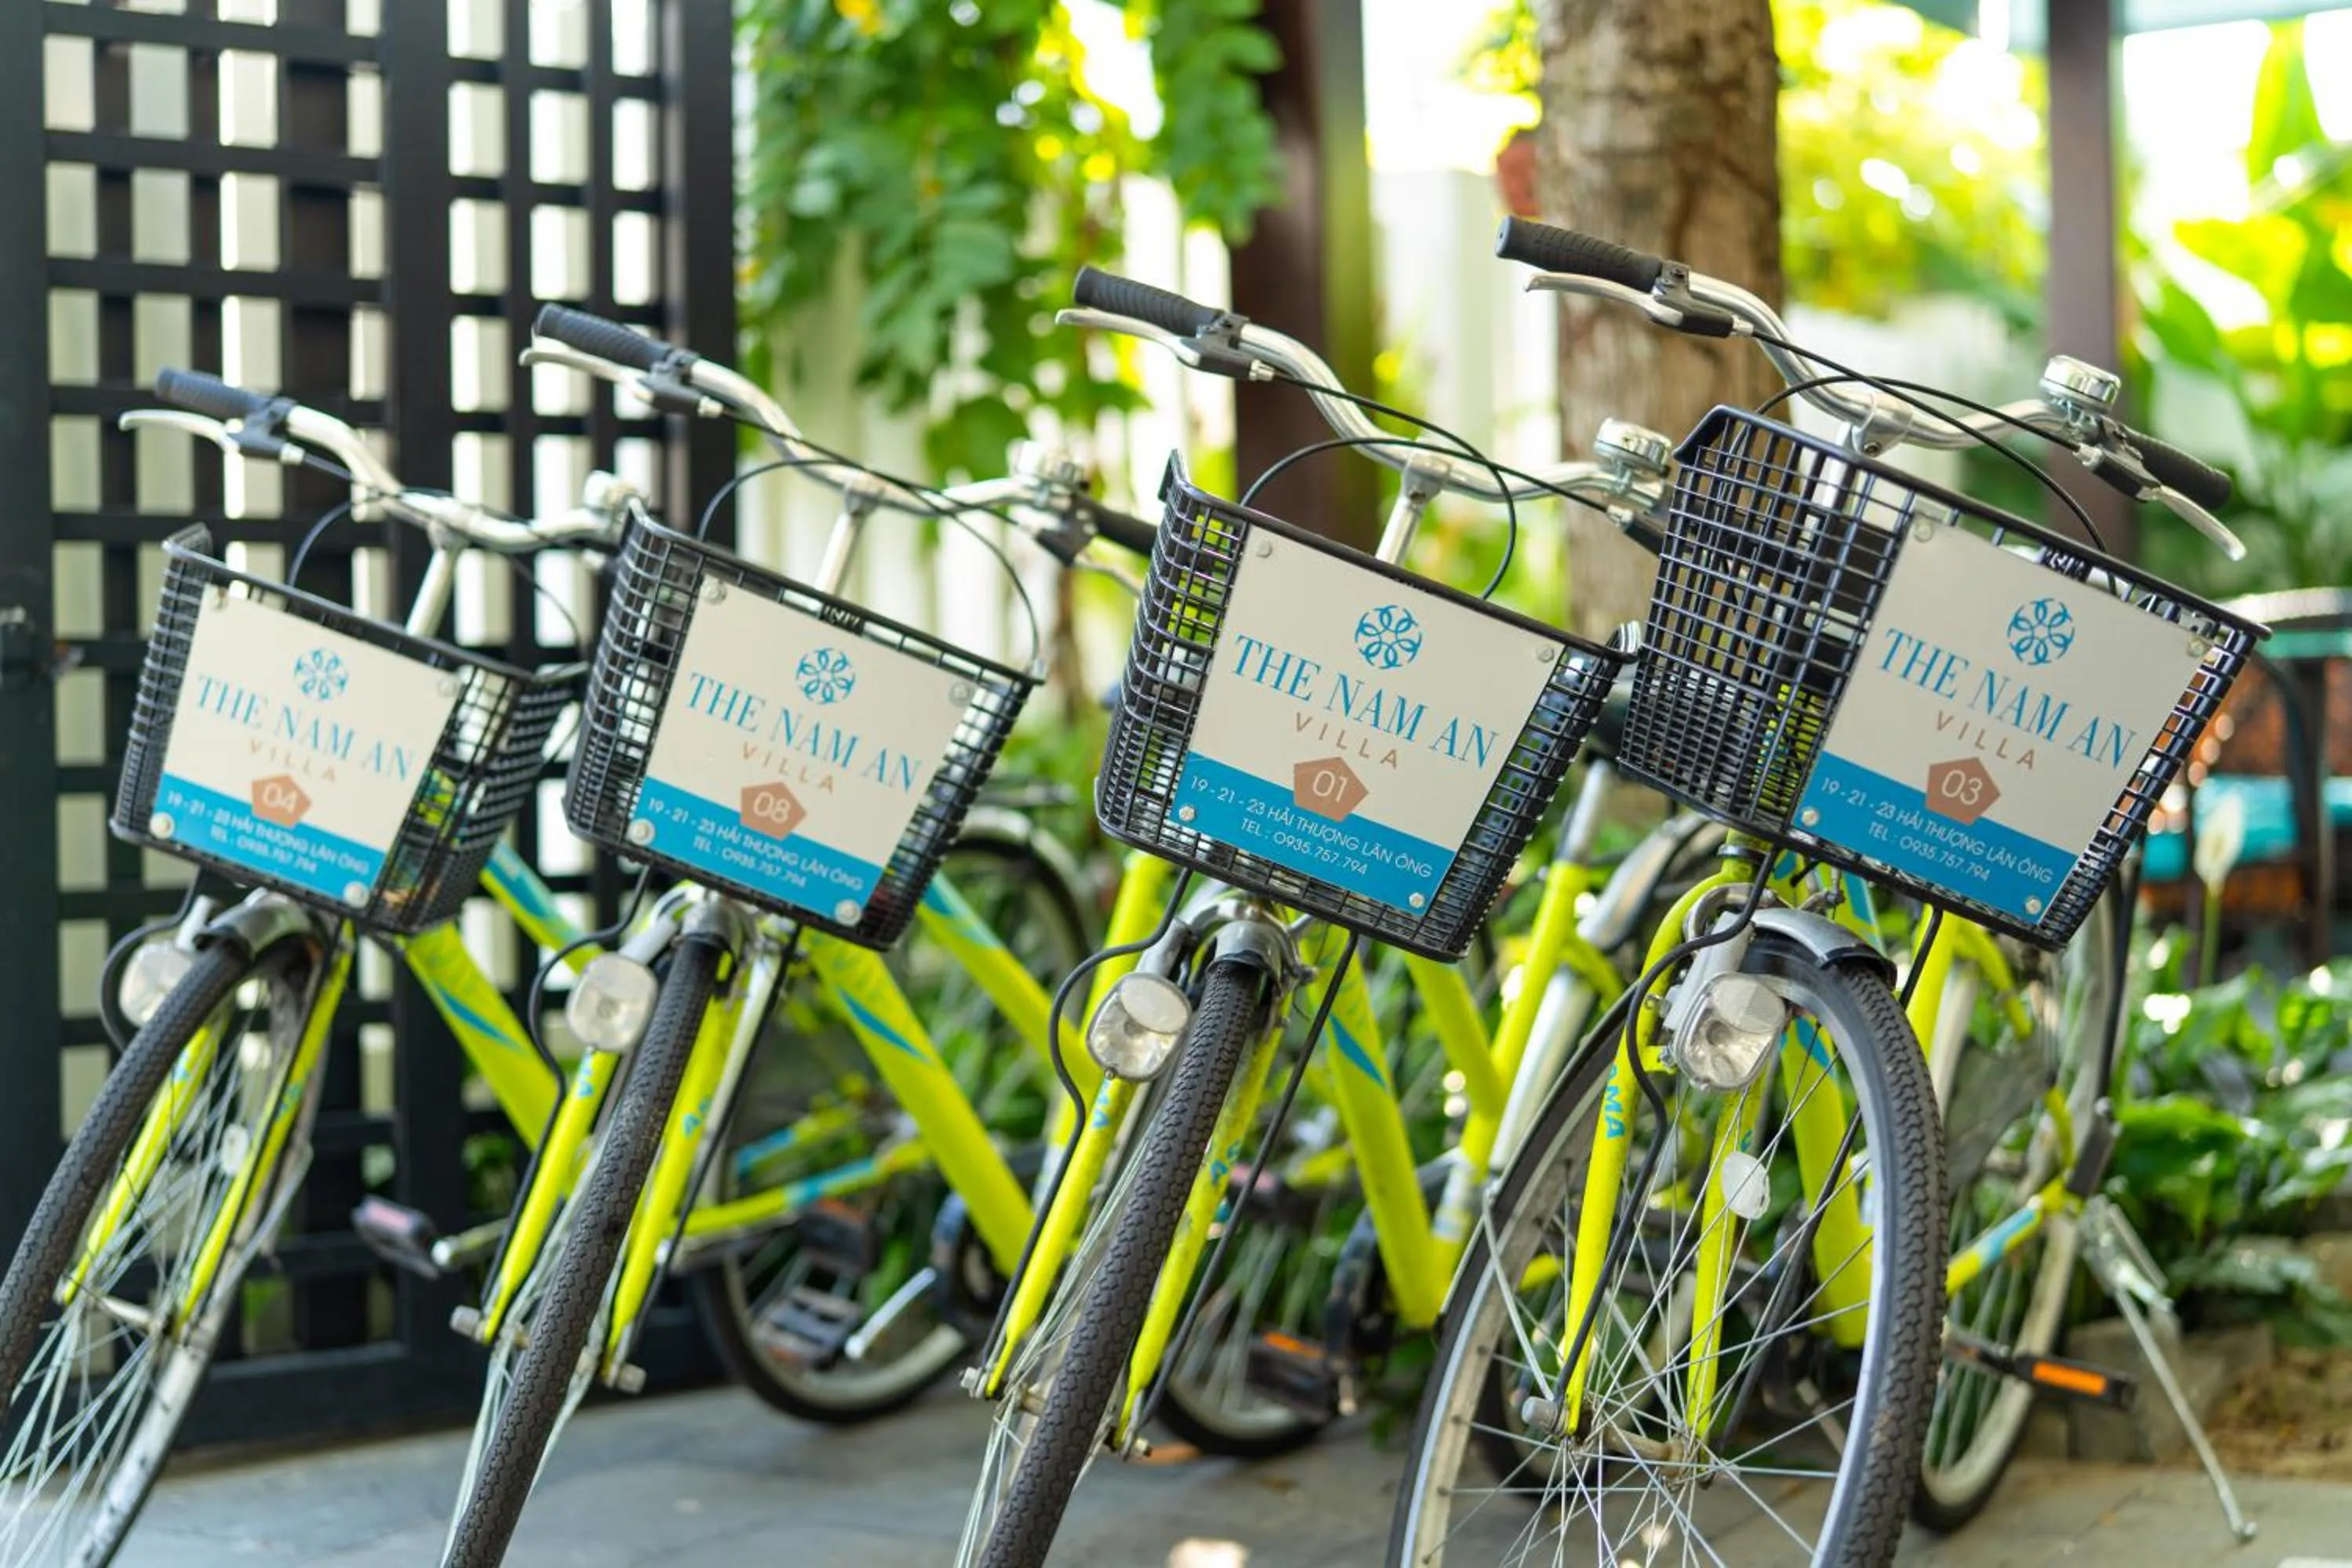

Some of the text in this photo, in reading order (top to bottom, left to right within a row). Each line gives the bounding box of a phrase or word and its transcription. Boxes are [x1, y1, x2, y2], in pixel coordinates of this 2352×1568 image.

[198, 675, 415, 782] THE NAM AN
[1230, 633, 1499, 769] THE NAM AN
[1878, 628, 2137, 771] THE NAM AN
[249, 739, 337, 782] VILLA
[686, 672, 923, 793] THE NAM AN
[1294, 712, 1399, 770] VILLA
[1936, 711, 2038, 771] VILLA
[742, 742, 834, 794] VILLA
[1312, 770, 1348, 803] 01
[1941, 770, 1983, 805] 03
[262, 783, 298, 812] 04
[648, 797, 664, 813] 19
[671, 808, 688, 823] 21
[753, 792, 791, 823] 08
[1191, 775, 1208, 790] 19
[1217, 787, 1235, 803] 21
[1246, 798, 1265, 816] 23
[1266, 806, 1294, 826] HẢI
[1296, 815, 1359, 851] THƯỢNG
[1395, 852, 1432, 877] ÔNG
[1241, 818, 1262, 837] TEL
[1273, 831, 1368, 876] 0935.757.794
[1820, 778, 1840, 794] 19
[1847, 789, 1867, 808] 21
[1876, 801, 1895, 820] 23
[1896, 810, 1923, 830] HẢI
[2017, 857, 2054, 884] ÔNG
[1868, 822, 1889, 842] TEL
[1899, 835, 1990, 882] 0935.757.794
